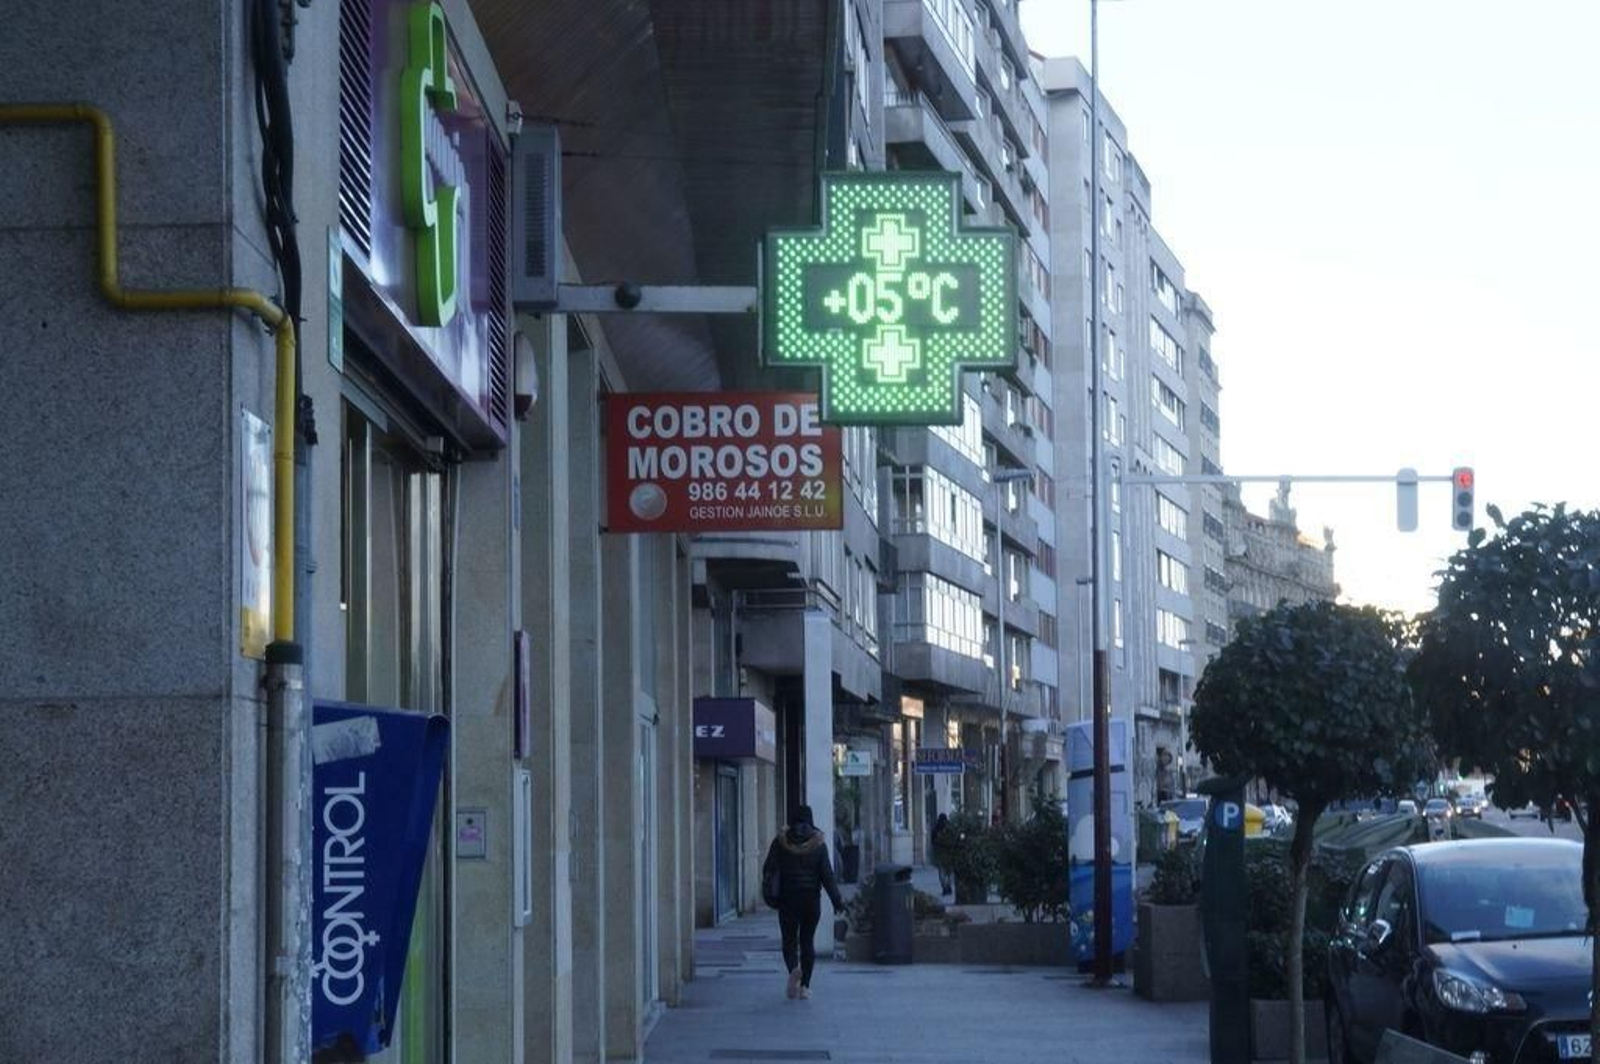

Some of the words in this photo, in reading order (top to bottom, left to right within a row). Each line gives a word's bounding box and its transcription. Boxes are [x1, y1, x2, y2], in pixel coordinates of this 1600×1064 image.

[627, 404, 760, 439] COBRO
[774, 404, 822, 437] DE
[627, 444, 824, 480] MOROSOS
[688, 481, 728, 501] 986
[734, 481, 761, 501] 44
[769, 481, 793, 501] 12
[800, 480, 826, 500] 42
[689, 506, 744, 519] GESTION
[1222, 803, 1240, 827] P
